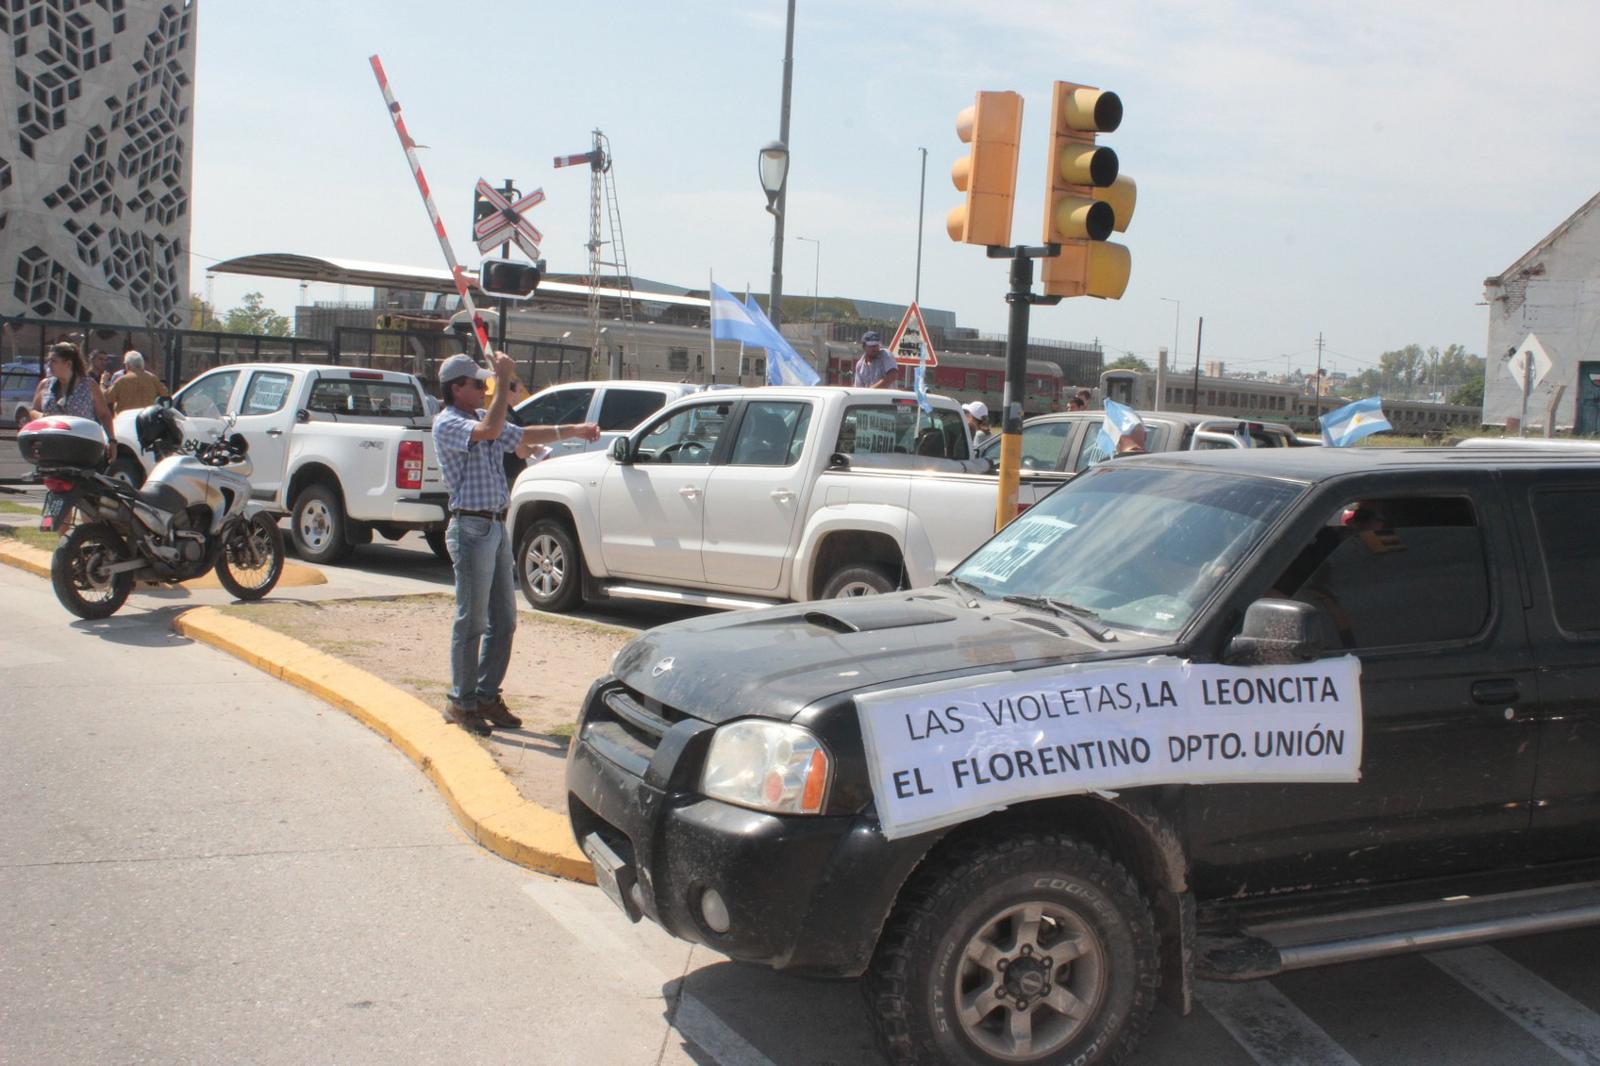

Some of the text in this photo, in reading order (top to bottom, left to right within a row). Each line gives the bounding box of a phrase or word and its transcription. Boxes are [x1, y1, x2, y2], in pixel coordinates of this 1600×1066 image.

[905, 706, 965, 741] LAS
[1201, 676, 1340, 706] LEONCITA
[892, 722, 1345, 800] EL FLORENTINO DPTO. UNIÓN
[1034, 878, 1119, 926] COOPER
